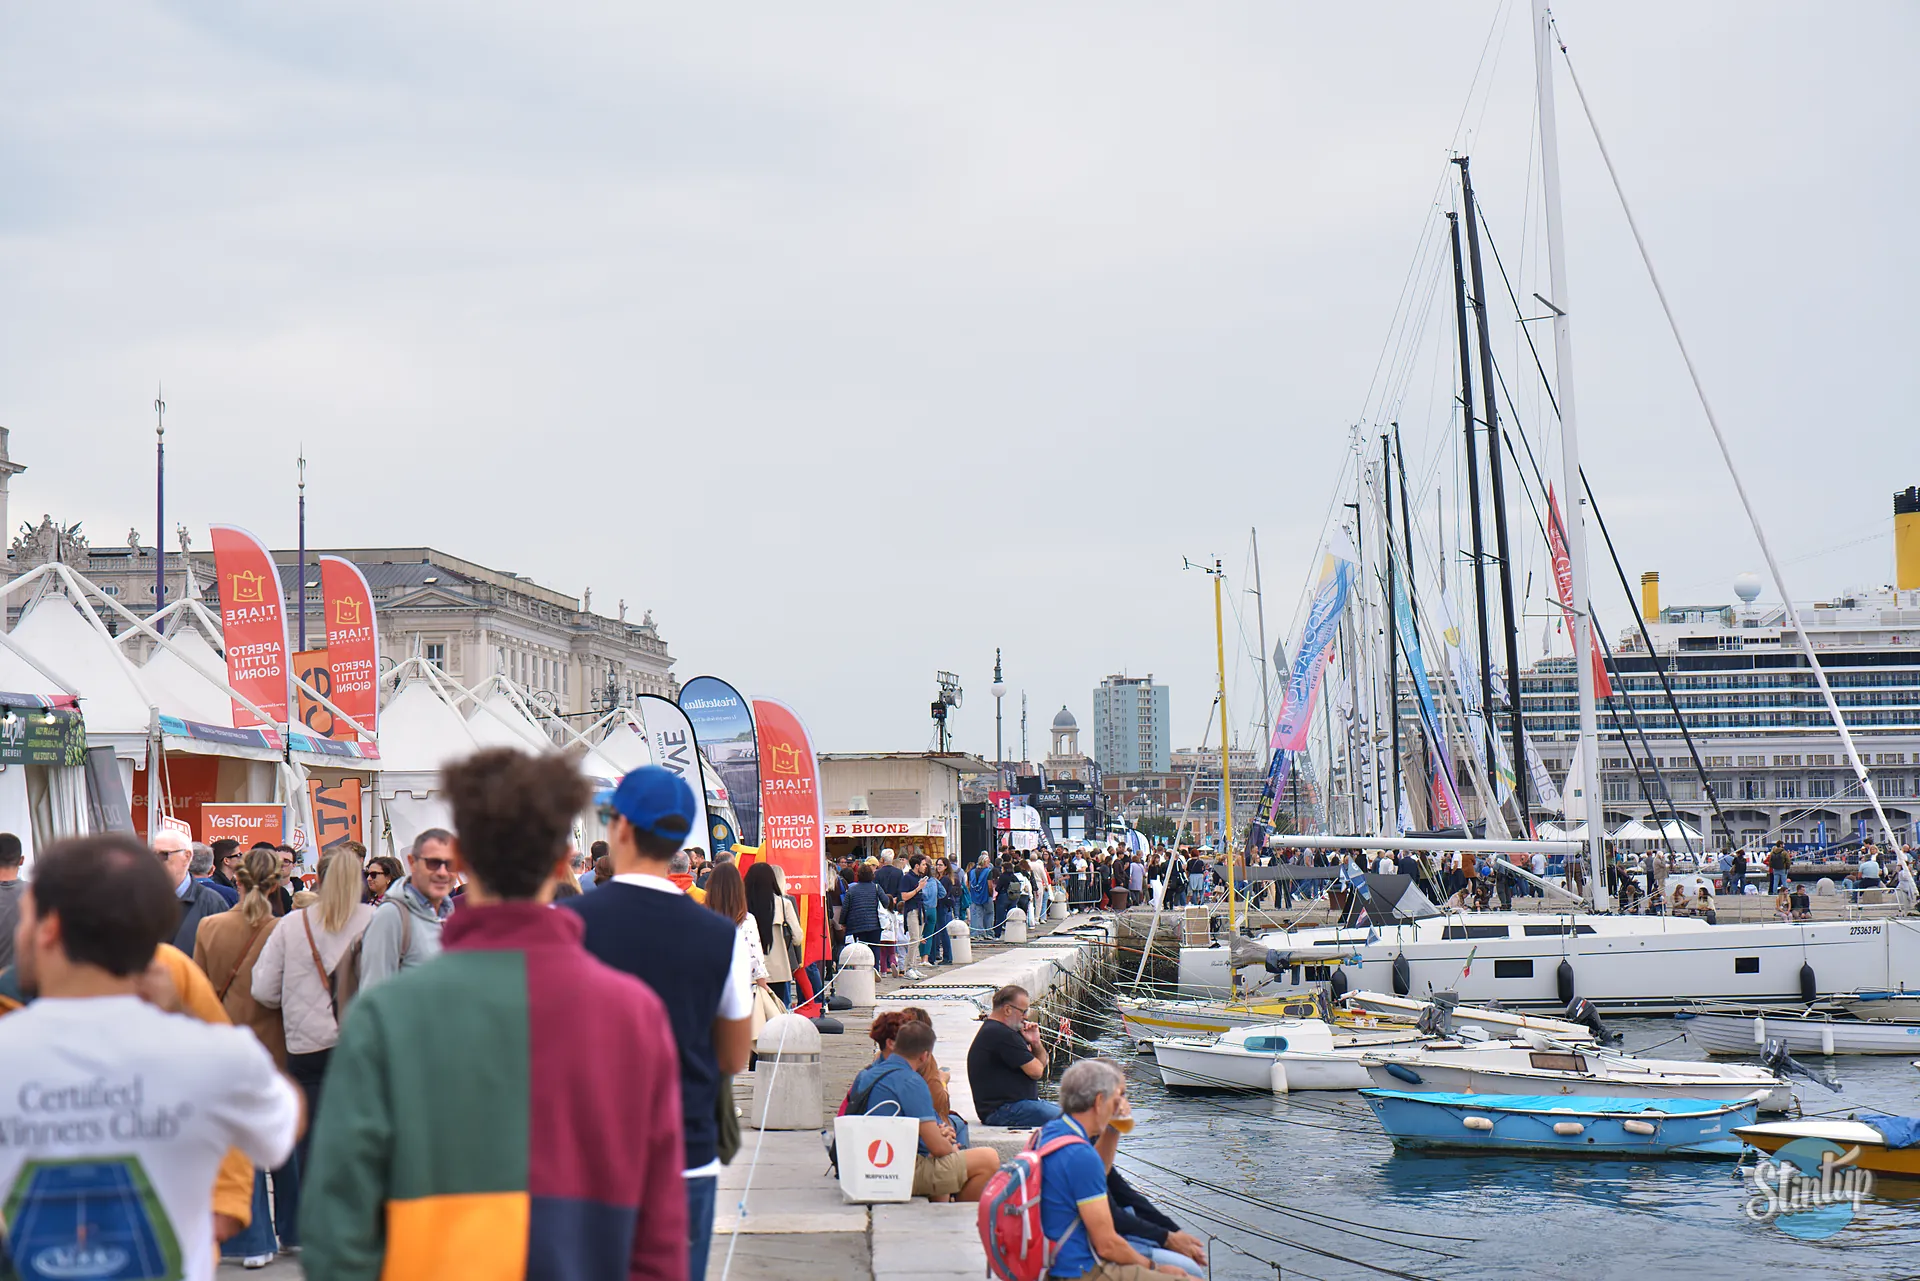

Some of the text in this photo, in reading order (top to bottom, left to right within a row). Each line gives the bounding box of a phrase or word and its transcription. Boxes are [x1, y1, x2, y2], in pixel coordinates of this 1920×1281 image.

[1281, 594, 1327, 722] MONFALCONE
[208, 814, 263, 828] YesTour
[835, 824, 846, 834] E
[852, 824, 909, 834] BUONE
[1850, 926, 1881, 935] 275363 PU
